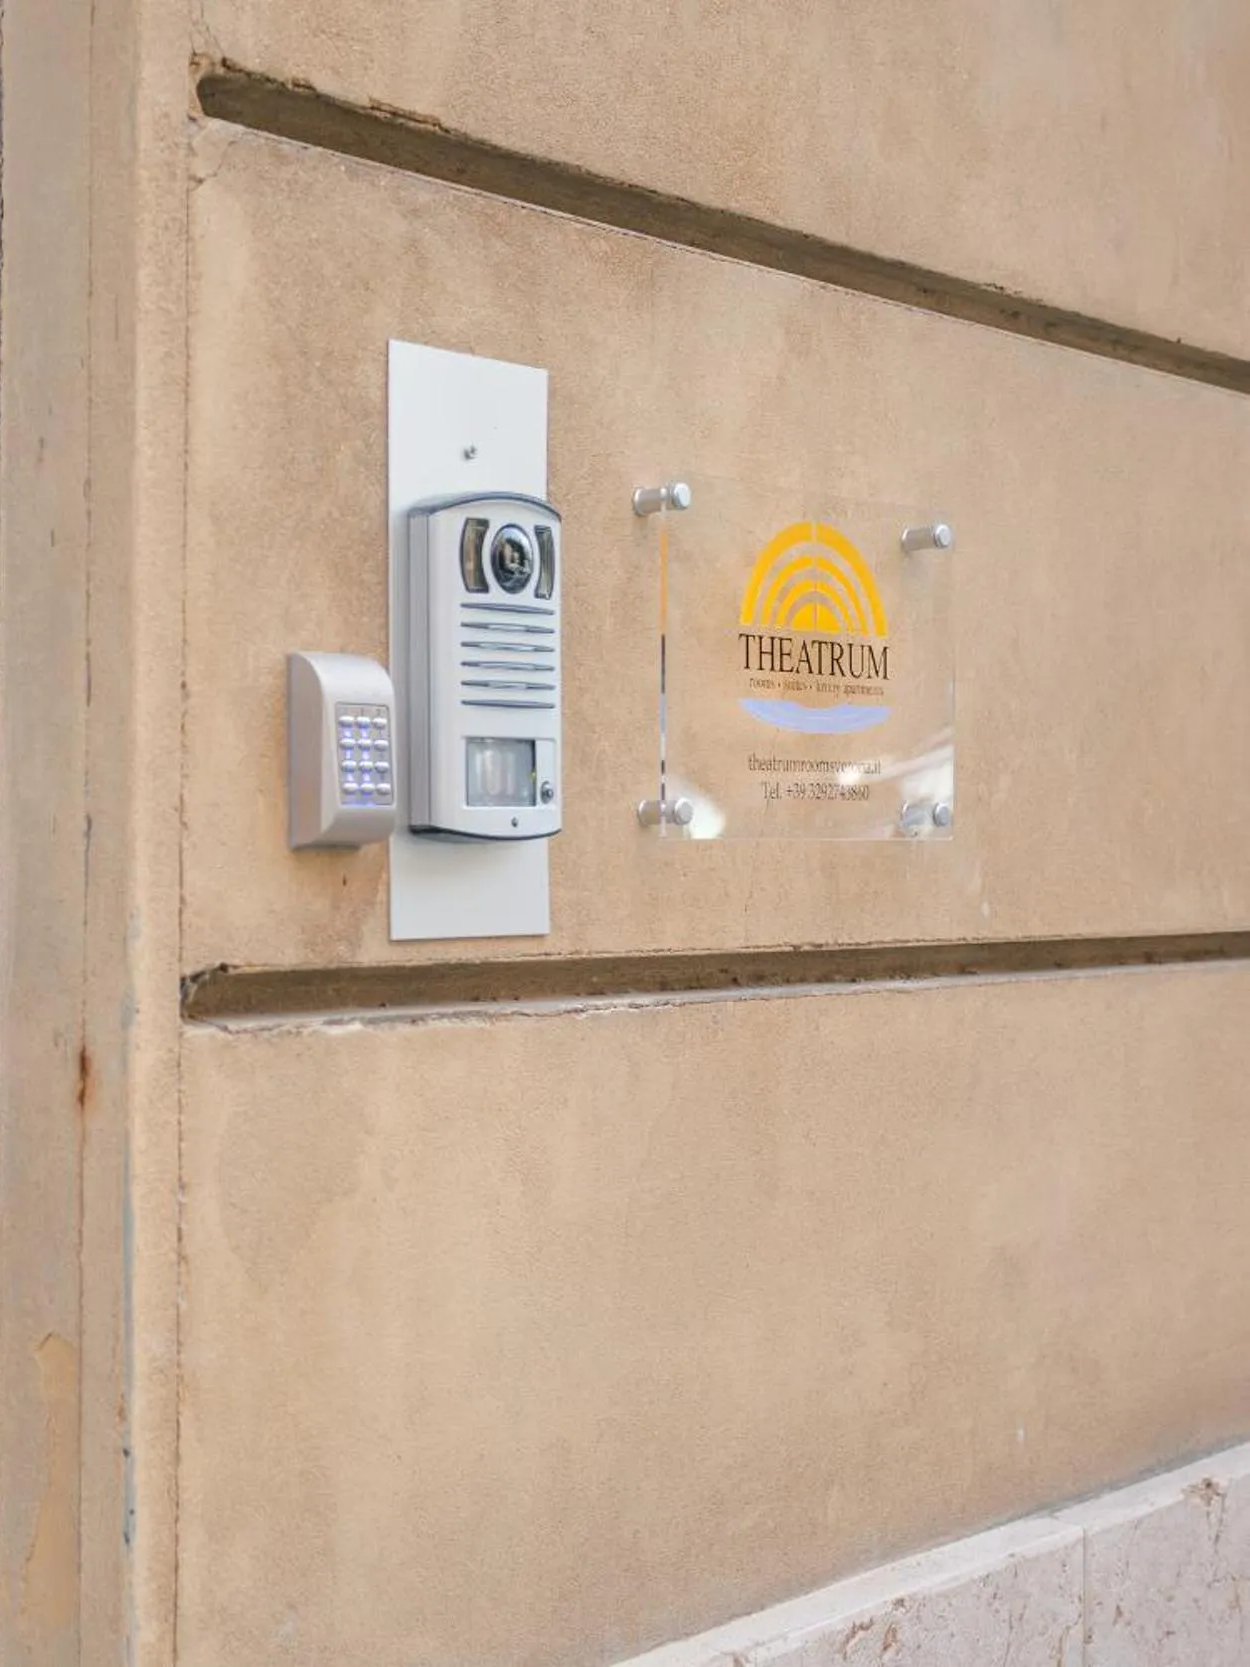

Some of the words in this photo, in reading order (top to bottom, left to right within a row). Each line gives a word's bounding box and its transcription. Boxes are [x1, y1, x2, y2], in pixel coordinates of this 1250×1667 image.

[739, 633, 890, 681] THEATRUM
[761, 781, 782, 800] Tel.
[786, 782, 806, 801] +39
